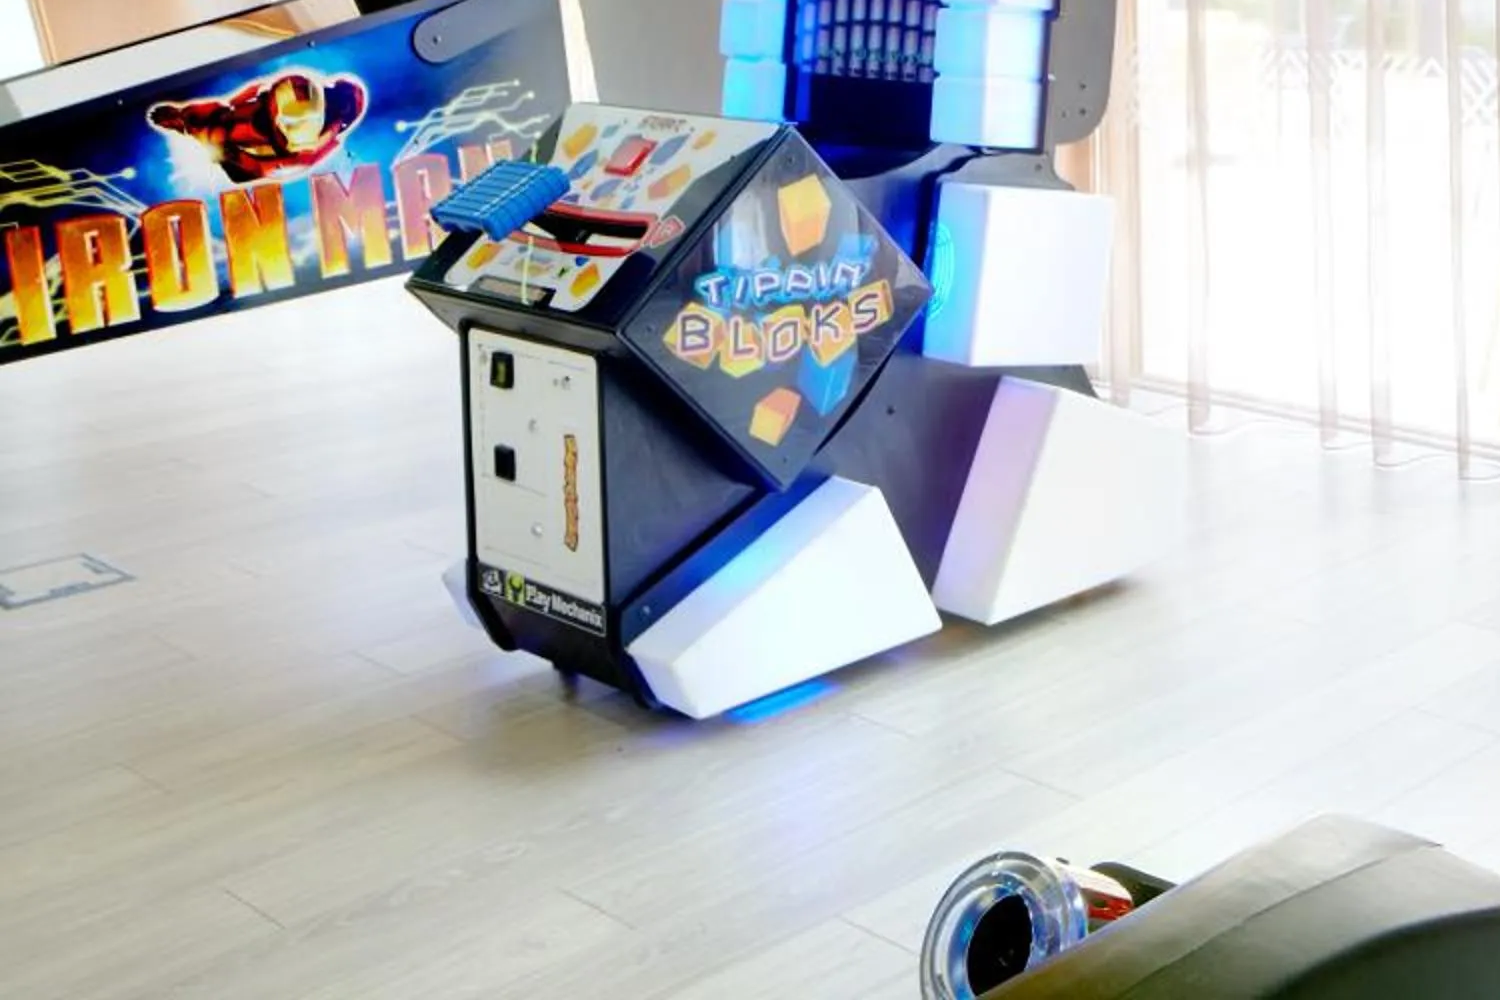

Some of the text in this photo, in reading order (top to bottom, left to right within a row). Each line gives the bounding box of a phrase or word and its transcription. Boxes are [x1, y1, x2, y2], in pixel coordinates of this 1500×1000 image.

[6, 138, 513, 345] IRON MA
[679, 292, 882, 359] BLOKS
